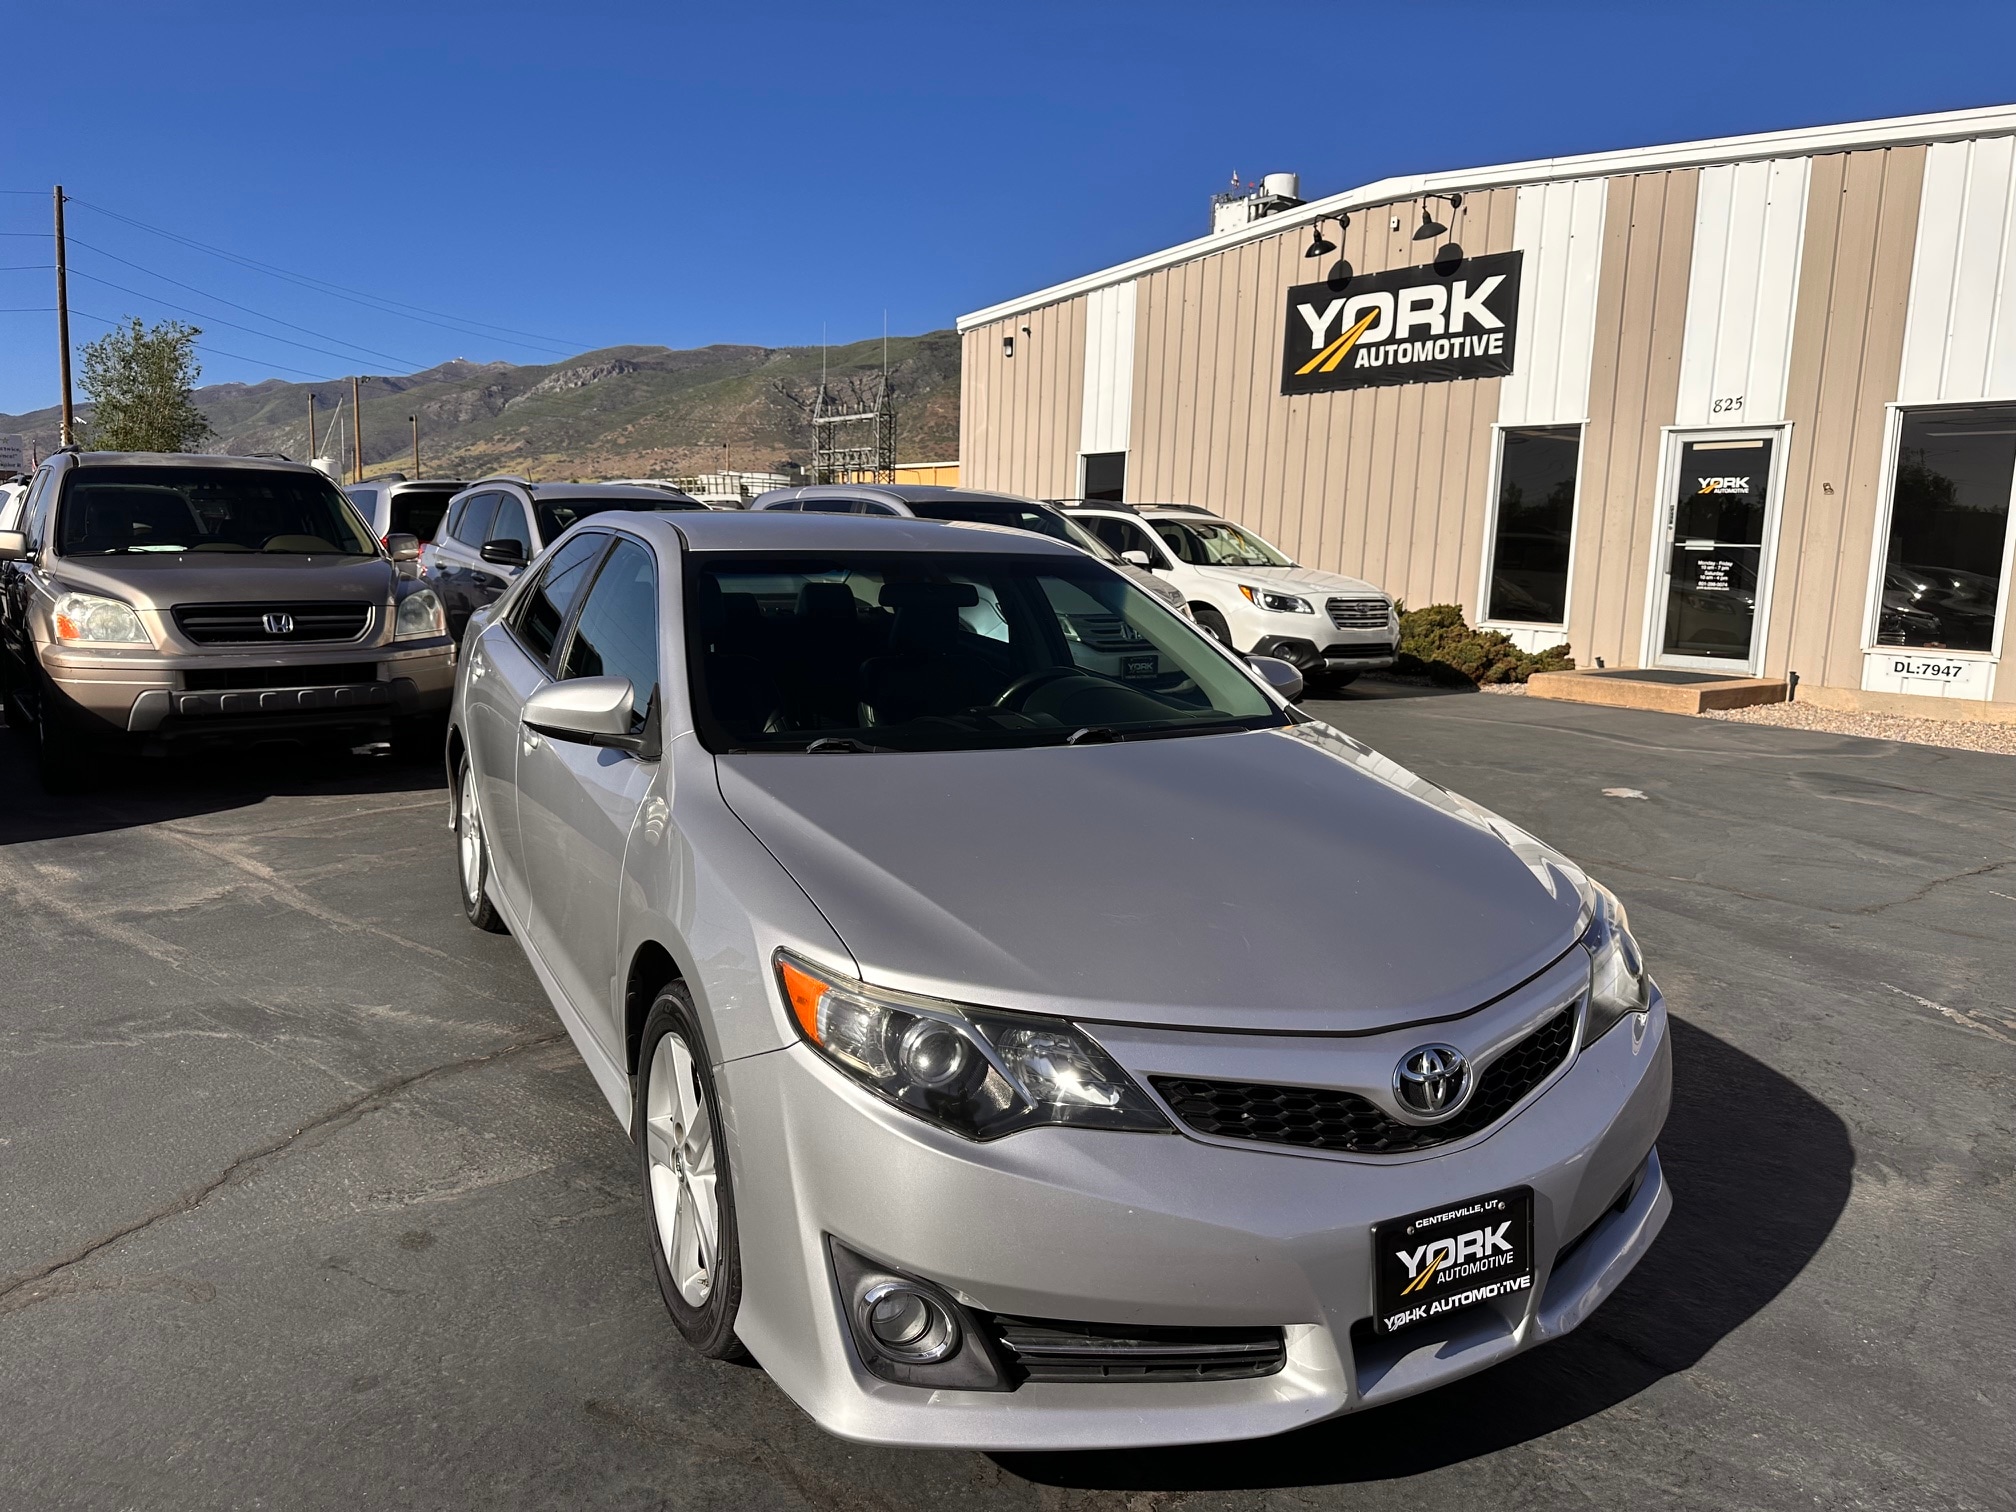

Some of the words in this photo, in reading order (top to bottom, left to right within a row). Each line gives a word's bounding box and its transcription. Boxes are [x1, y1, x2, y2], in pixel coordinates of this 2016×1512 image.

[1296, 274, 1507, 350] YORK
[1354, 332, 1504, 369] AUTOMOTIVE
[1712, 396, 1743, 413] 825
[1697, 476, 1750, 489] YORK
[1894, 661, 1962, 677] DL:7947
[1415, 1204, 1484, 1228] CENTERVILLE,
[1485, 1199, 1498, 1210] UT
[1395, 1220, 1513, 1279] YORK
[1436, 1251, 1514, 1284] AUTOMOTIVE
[1430, 1275, 1531, 1315] AUTOMOTIVE
